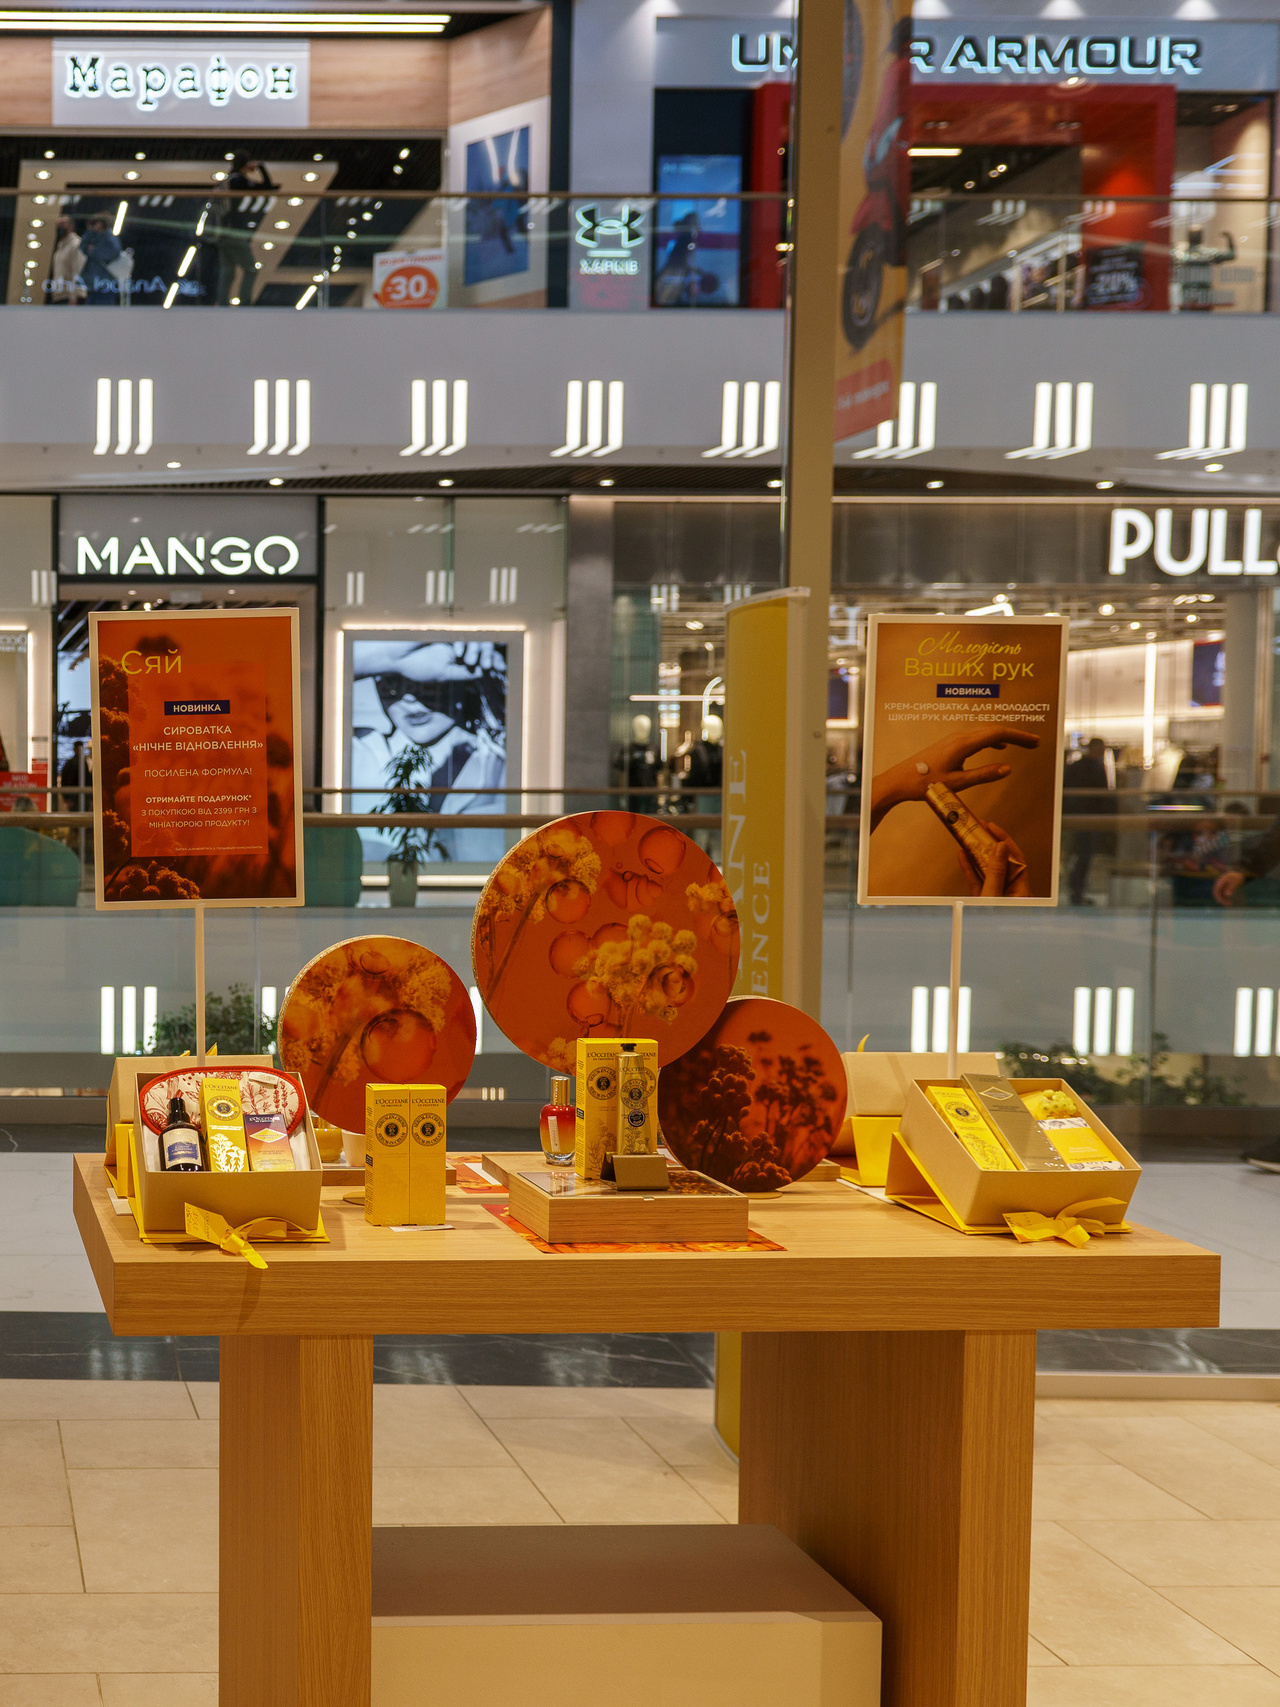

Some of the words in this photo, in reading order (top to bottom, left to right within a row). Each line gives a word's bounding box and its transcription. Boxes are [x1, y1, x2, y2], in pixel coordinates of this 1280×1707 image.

[940, 34, 1203, 76] ARMOUR
[64, 53, 297, 111] Марафон
[1109, 508, 1280, 576] PULL
[77, 535, 300, 577] MANGO
[918, 631, 1022, 668] Молодість
[121, 648, 183, 675] Сяй
[904, 658, 984, 677] Ваших
[992, 661, 1034, 681] рук
[945, 687, 991, 696] НОВИНКА
[173, 703, 222, 713] НОВИНКА
[884, 703, 970, 712] КРЕМ-СИРОВАТКА
[971, 703, 993, 712] ДЛЯ
[994, 703, 1050, 713] МОЛОДОСТІ
[888, 713, 920, 722] ШКІРИ
[922, 714, 941, 722] РУК
[942, 714, 1046, 723] КАРІТЕ-БЕЗСМЕРТНИК
[163, 725, 232, 736] СИРОВАТКА
[132, 742, 173, 752] «НІЧНЕ
[175, 740, 264, 752] ВІДНОВЛЕННЯ»
[144, 768, 199, 778] ПОСИЛЕНА
[201, 767, 252, 777] ФОРМУЛА!
[145, 794, 196, 804] ОТРИМАЙТЕ
[148, 807, 196, 816] ПОКУПКОЮ
[197, 807, 212, 816] ВІД
[213, 806, 232, 815] 2399
[234, 806, 250, 815] ГРН
[149, 820, 203, 829] МІНІАТЮРОЮ
[205, 819, 250, 828] ПРОДУКТУ!
